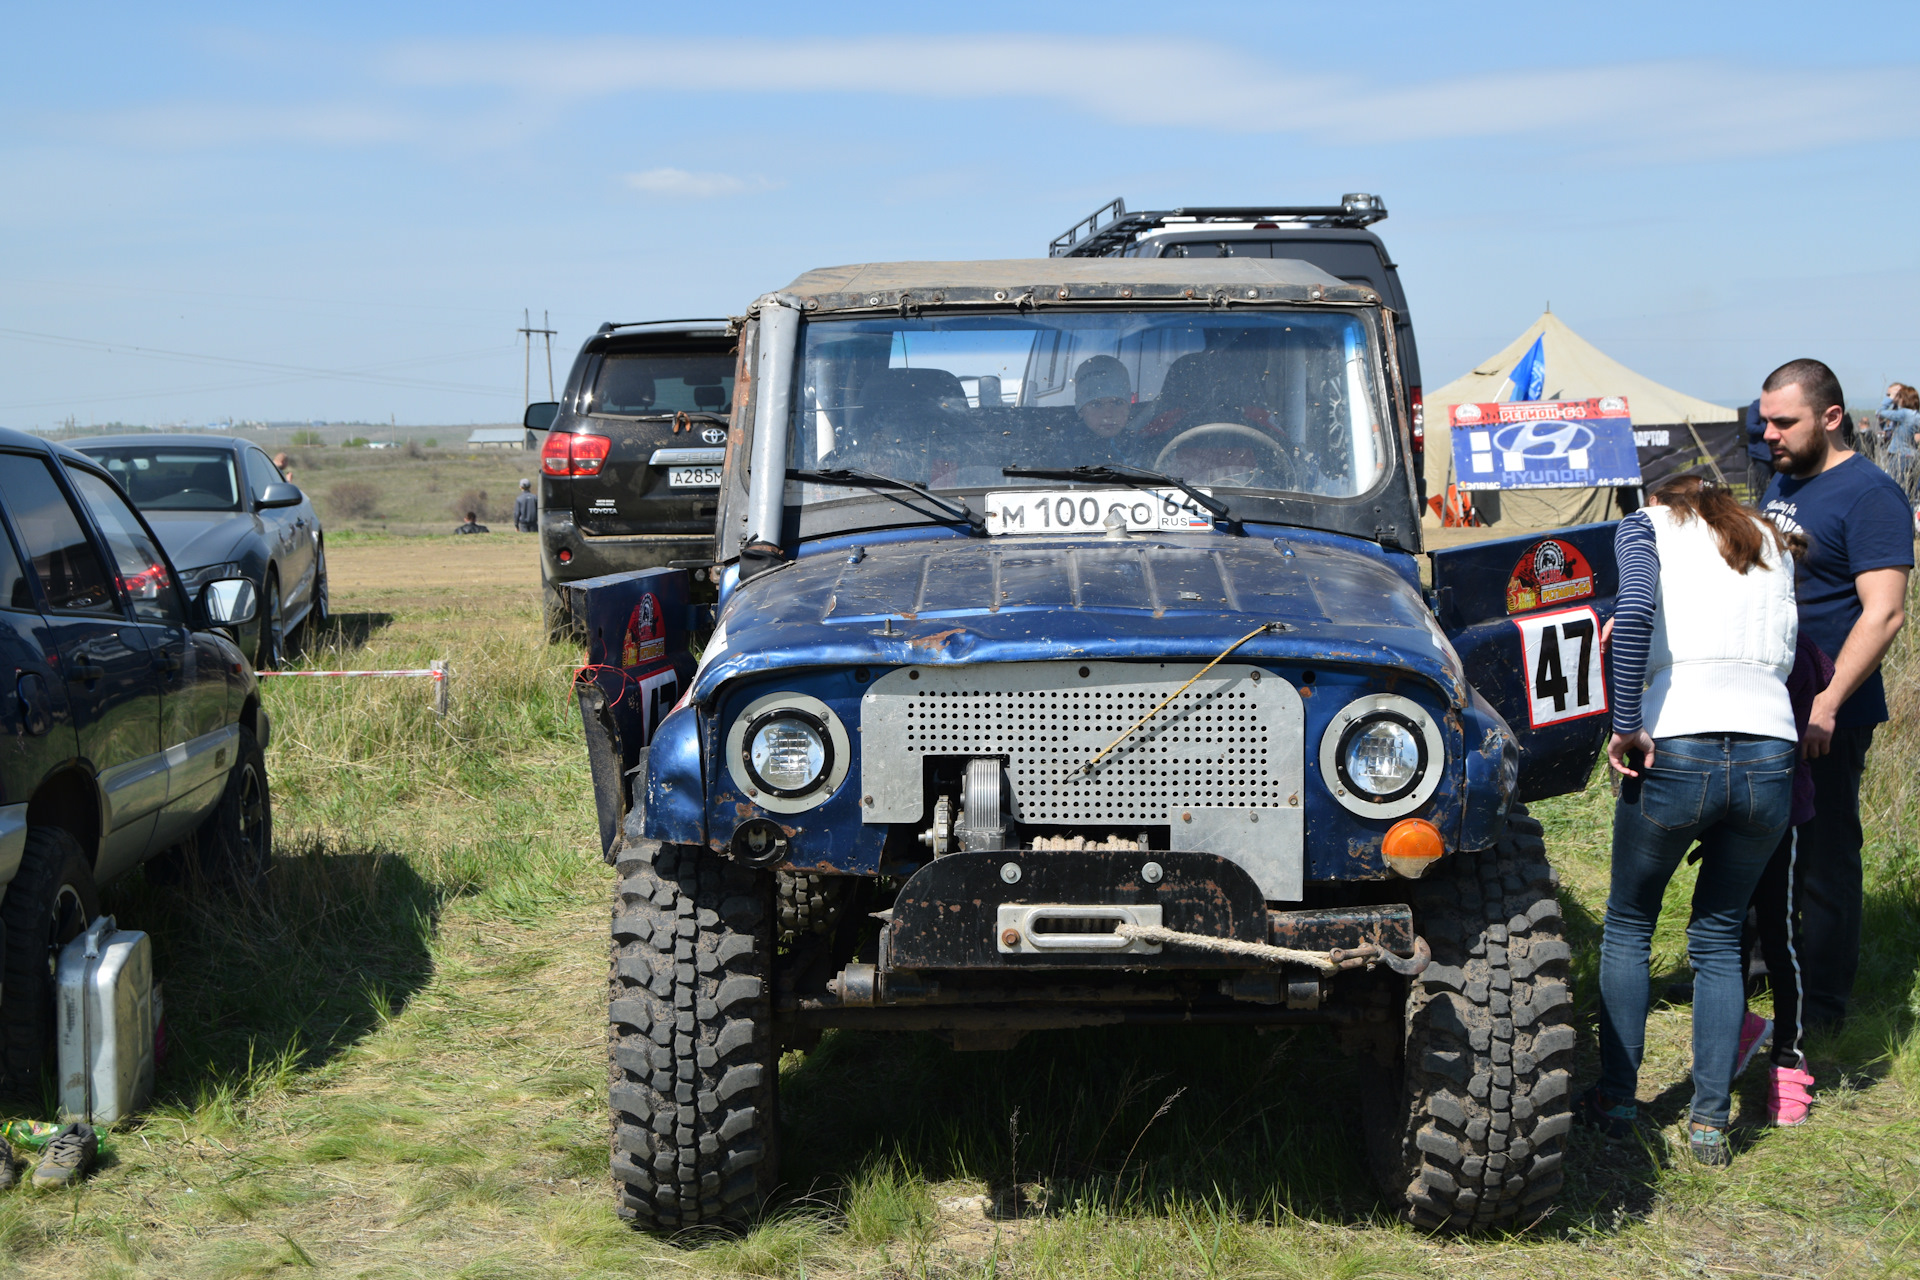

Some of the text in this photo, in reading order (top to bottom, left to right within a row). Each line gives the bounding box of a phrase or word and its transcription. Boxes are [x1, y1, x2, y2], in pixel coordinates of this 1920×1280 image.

[1501, 407, 1585, 421] РЕГИОН-64
[1502, 469, 1595, 483] HYUNDAI
[1466, 481, 1500, 490] ЭЛВИС
[1163, 493, 1198, 516] 64
[1162, 517, 1187, 526] RUS
[1540, 569, 1561, 584] CLUB
[1542, 581, 1591, 603] РЕГИОН-64
[1536, 618, 1593, 712] 47
